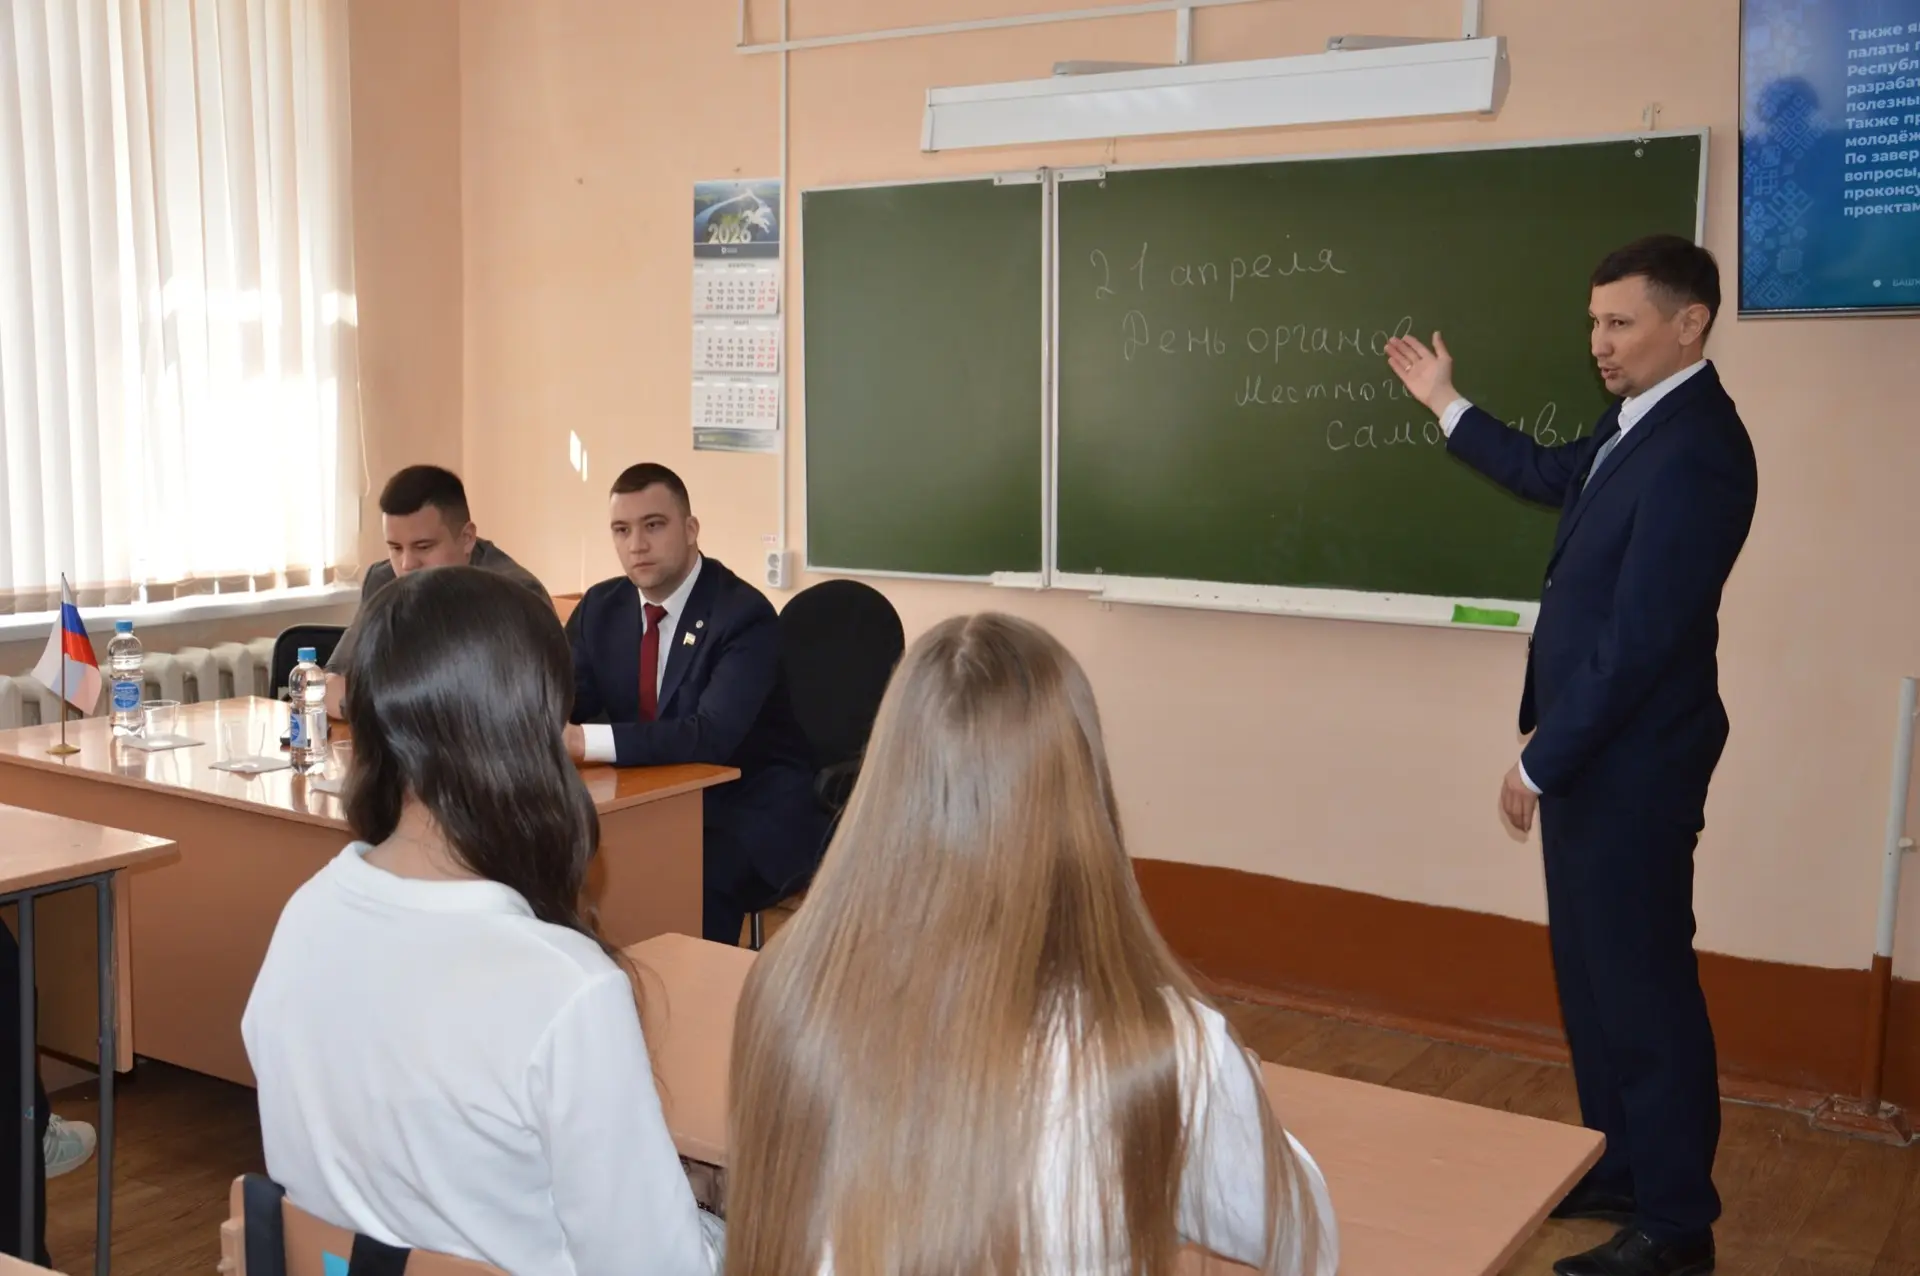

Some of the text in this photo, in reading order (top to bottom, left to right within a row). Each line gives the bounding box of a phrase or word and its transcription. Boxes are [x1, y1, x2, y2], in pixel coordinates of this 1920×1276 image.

[1848, 22, 1920, 41] Также я
[1848, 42, 1909, 59] палаты
[1847, 57, 1919, 77] Республ
[1846, 96, 1920, 112] полезны
[1845, 115, 1899, 130] Также
[1845, 130, 1920, 147] молодёж
[1845, 149, 1920, 164] По завер
[708, 222, 752, 245] 2026
[1122, 310, 1226, 361] День
